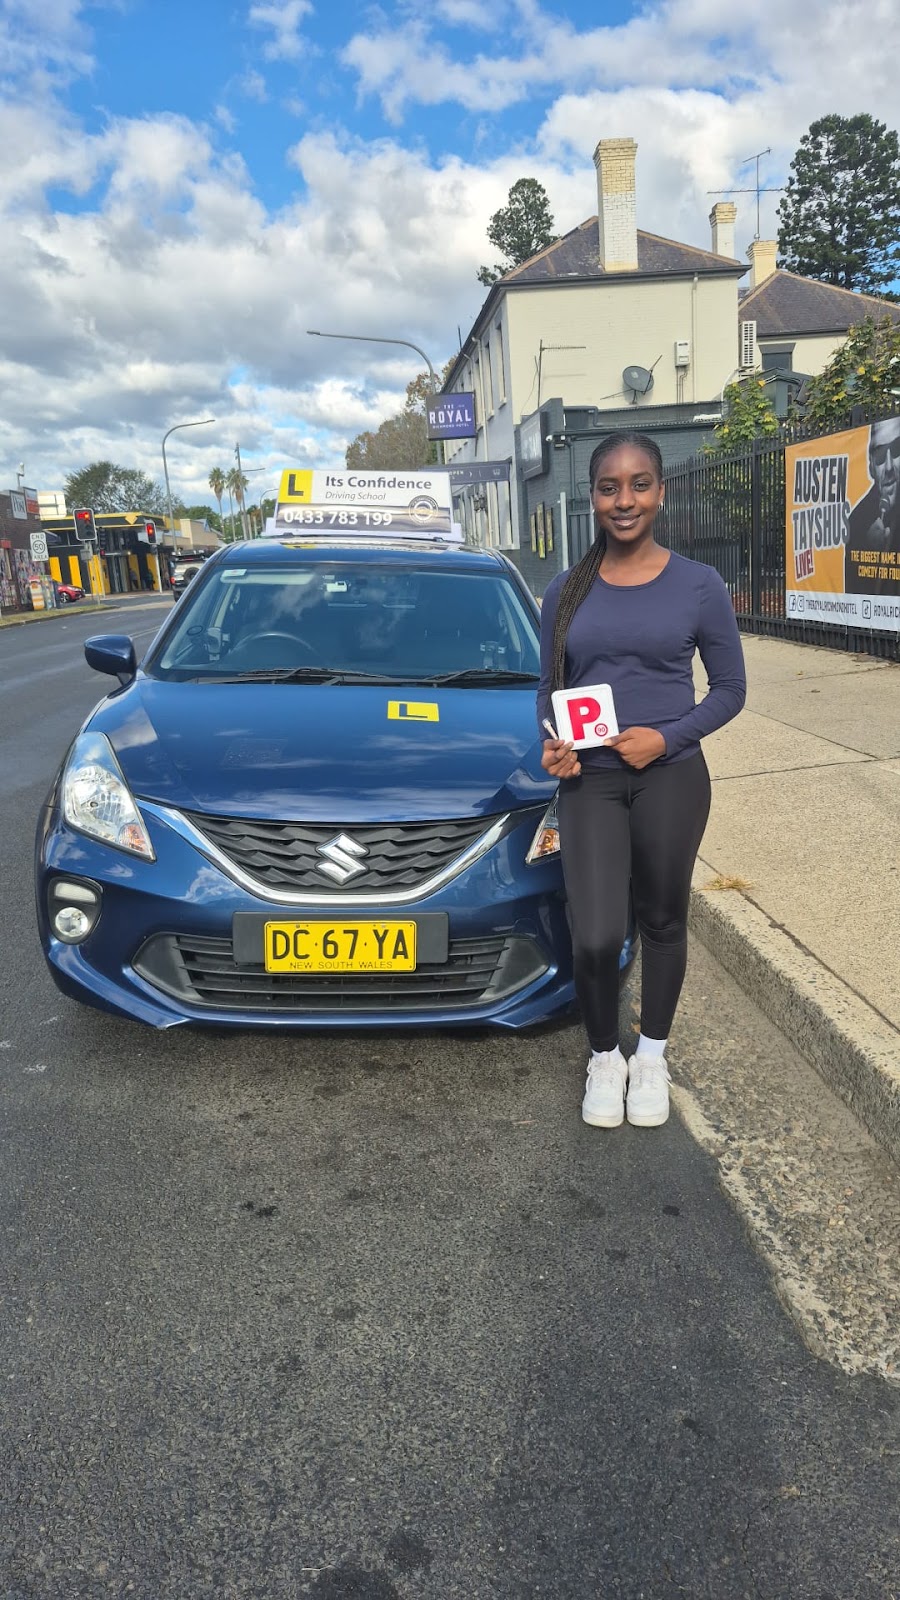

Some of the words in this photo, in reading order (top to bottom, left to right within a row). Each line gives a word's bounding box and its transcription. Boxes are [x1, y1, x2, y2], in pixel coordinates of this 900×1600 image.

[429, 409, 472, 424] ROYAL
[288, 474, 304, 496] L
[325, 476, 343, 487] Its
[348, 476, 432, 489] Confidence
[794, 457, 848, 504] AUSTEN
[325, 491, 355, 501] Driving
[358, 492, 386, 501] School
[283, 511, 324, 524] 0433
[329, 512, 358, 525] 783
[364, 512, 393, 526] 199
[792, 501, 851, 551] TAYSHUS
[34, 543, 43, 551] 50
[795, 549, 814, 580] LIVE!
[850, 550, 860, 562] THE
[860, 550, 880, 563] BIGGEST
[881, 551, 896, 564] NAME
[858, 565, 878, 578] COMEDY
[878, 567, 889, 579] FOR
[399, 703, 428, 719] L
[566, 696, 601, 741] P
[289, 962, 313, 970] NEW
[318, 961, 353, 969] SOUTH
[358, 961, 393, 969] WALES
